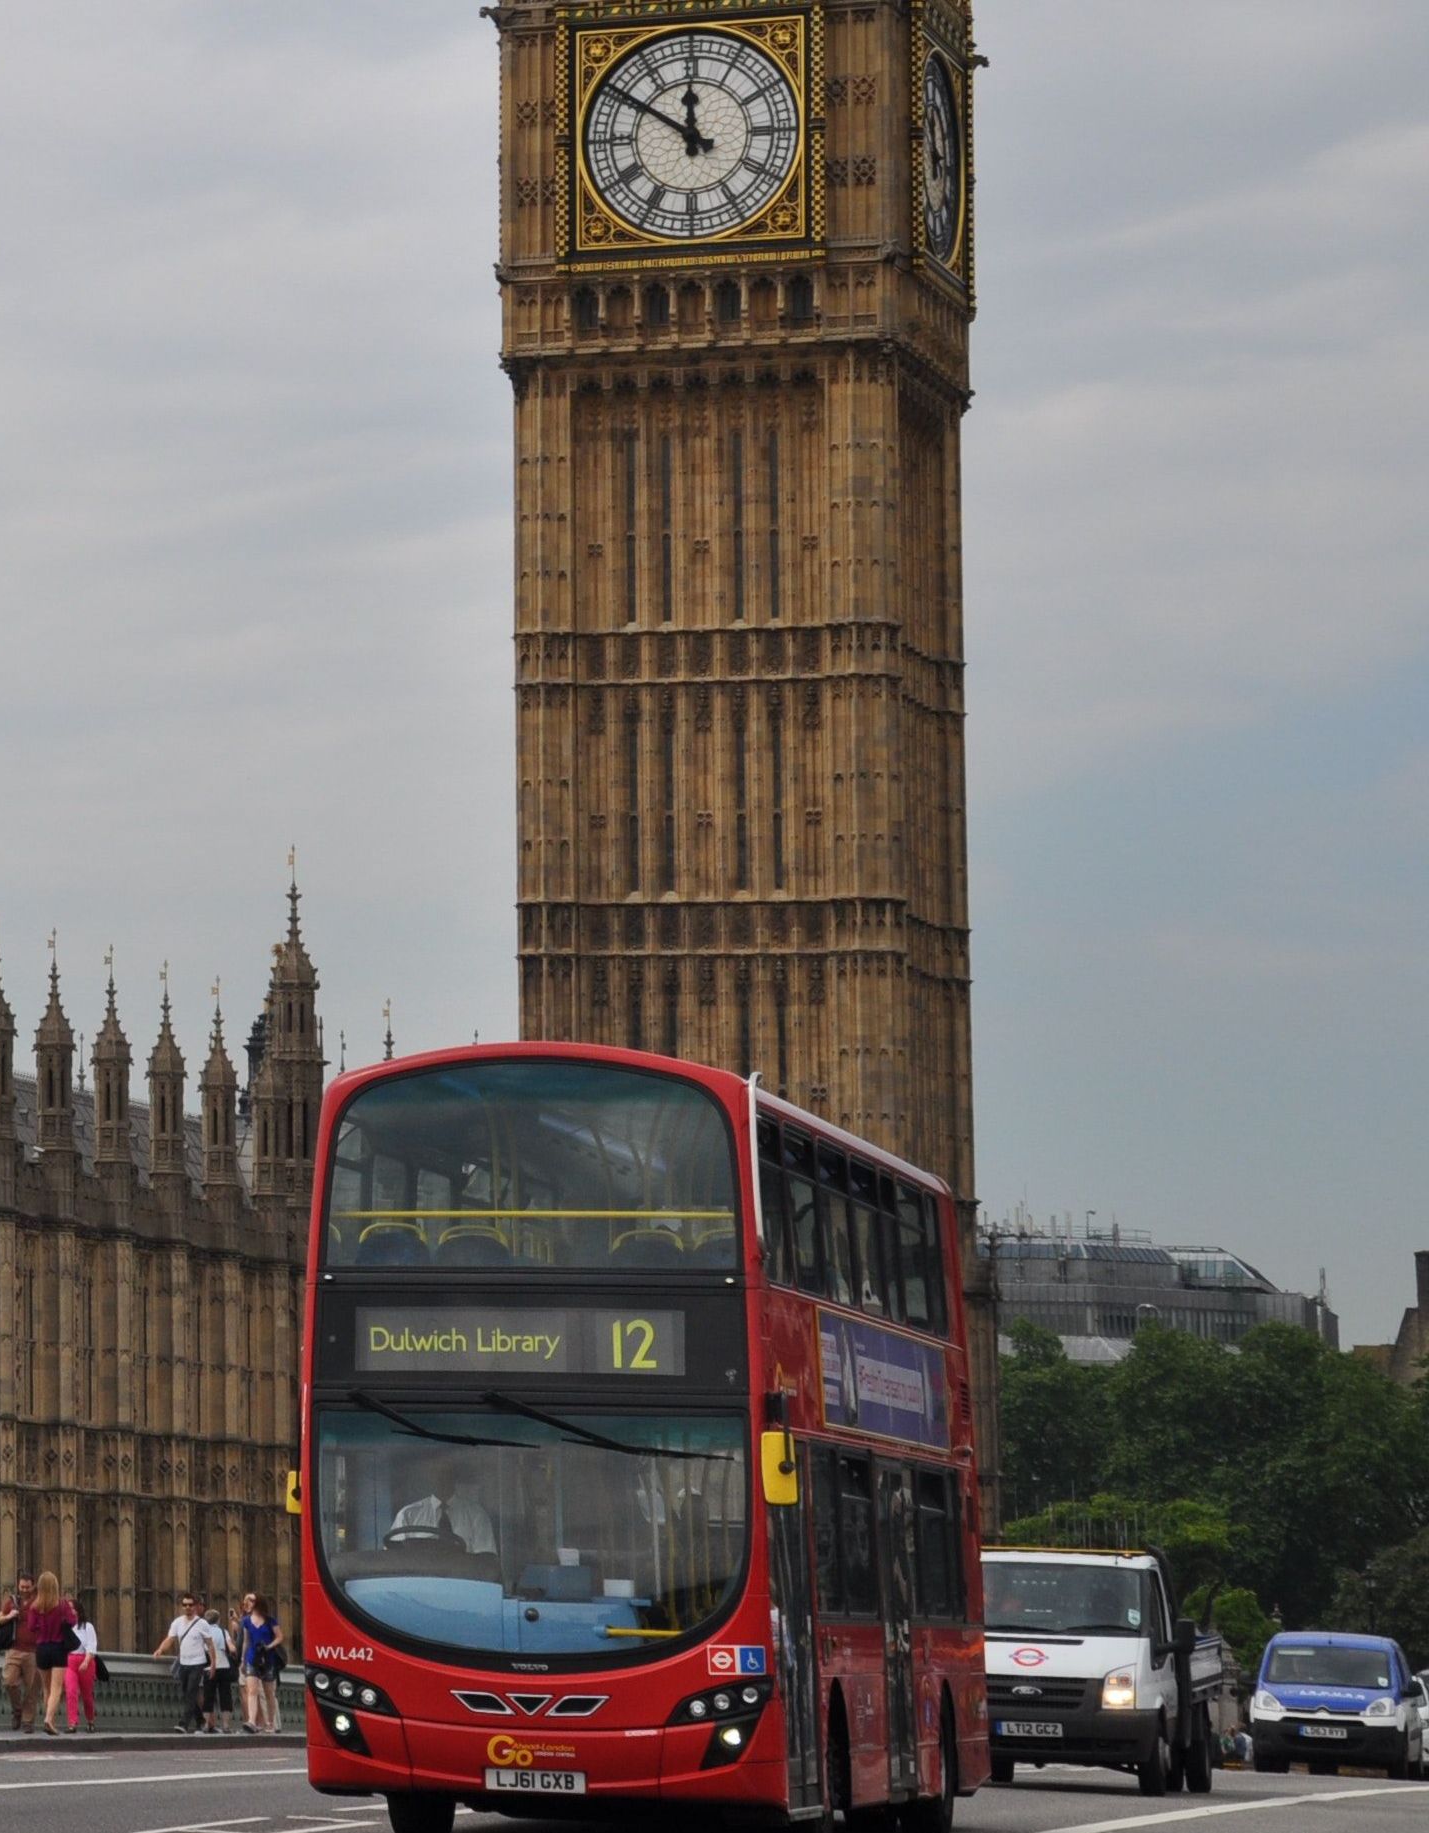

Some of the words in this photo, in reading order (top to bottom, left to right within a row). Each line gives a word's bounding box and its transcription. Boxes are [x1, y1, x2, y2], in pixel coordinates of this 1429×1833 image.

[369, 1327, 467, 1352] Dulwich
[477, 1327, 561, 1360] Library
[612, 1319, 658, 1369] 12
[315, 1645, 374, 1662] WVL442
[510, 1662, 549, 1671] VOLVO
[1006, 1723, 1033, 1735] LT12
[1035, 1724, 1059, 1736] GCZ
[487, 1734, 534, 1767] Go
[495, 1770, 535, 1789] LJ61
[540, 1772, 575, 1791] GXB
